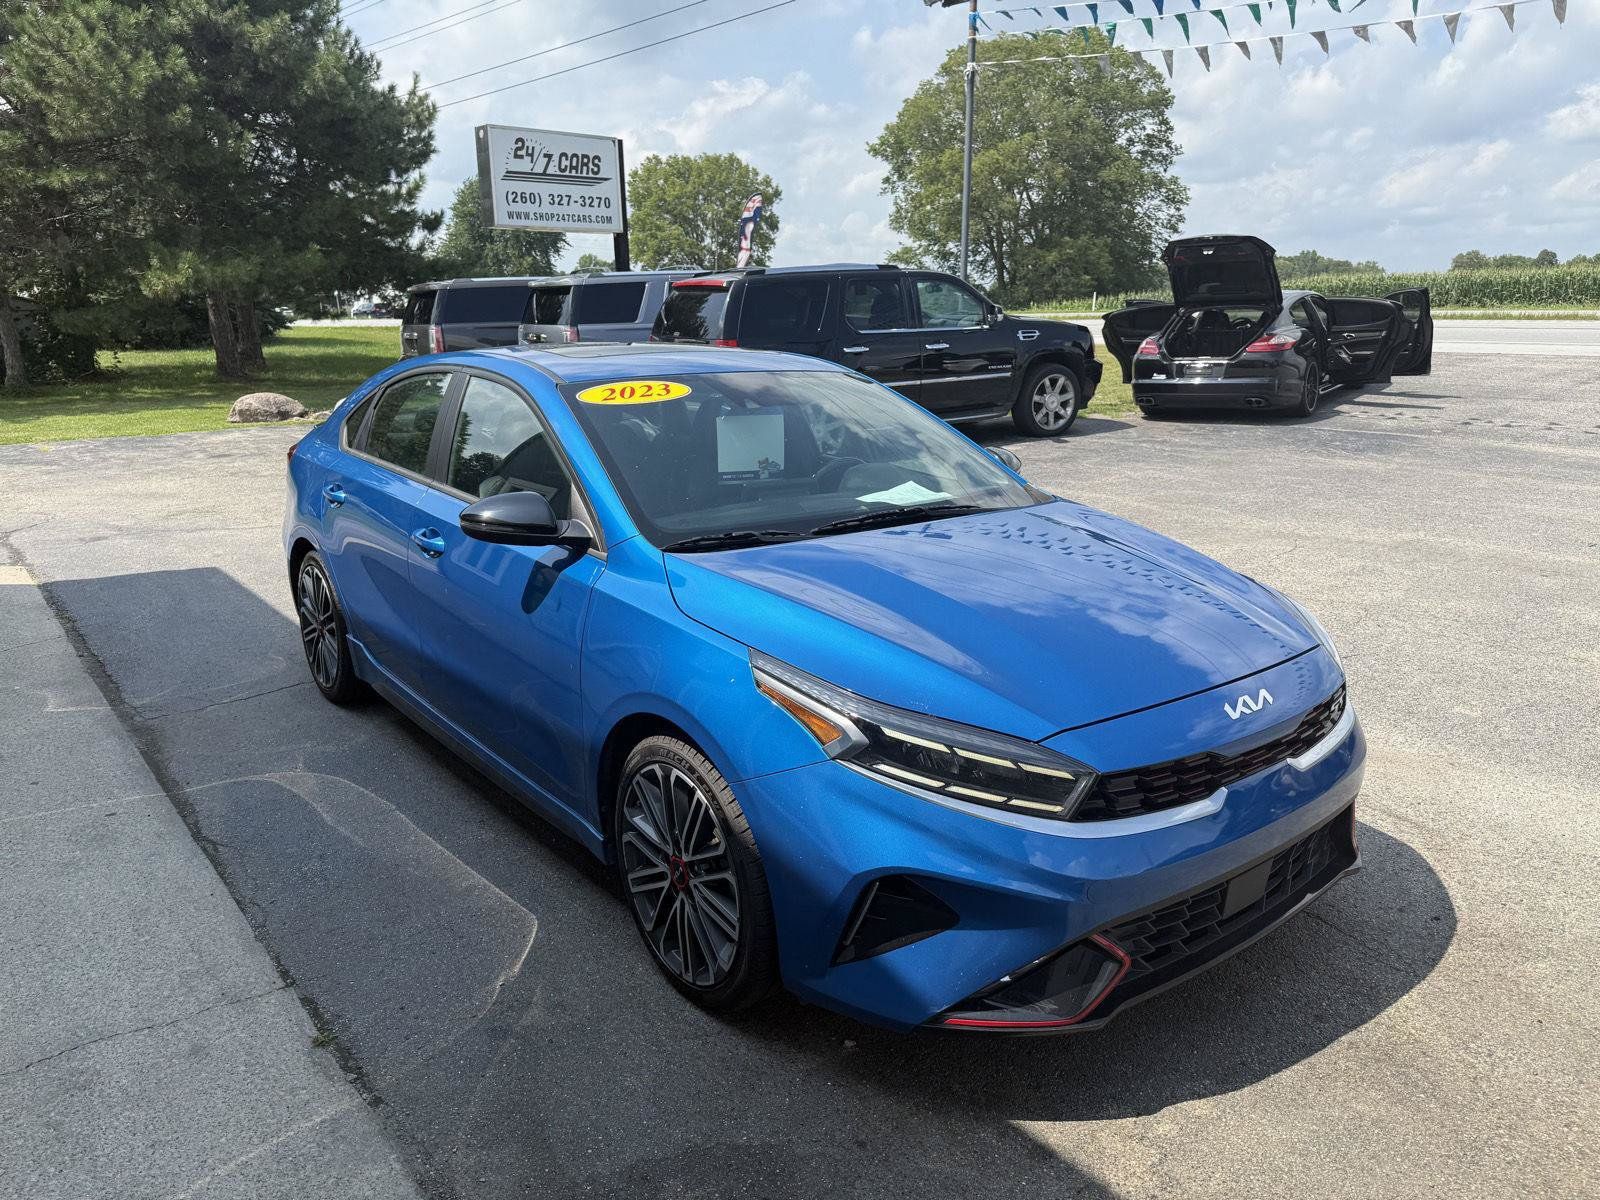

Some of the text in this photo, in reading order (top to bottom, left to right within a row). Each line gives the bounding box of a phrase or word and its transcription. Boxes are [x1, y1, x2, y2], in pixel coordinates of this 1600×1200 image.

[513, 137, 601, 176] 24/7 CARS
[505, 191, 611, 209] (260) 327-3270
[507, 211, 613, 224] WWW.SHOP247CARS.COM
[602, 383, 671, 401] 2023
[1224, 688, 1274, 720] KIA
